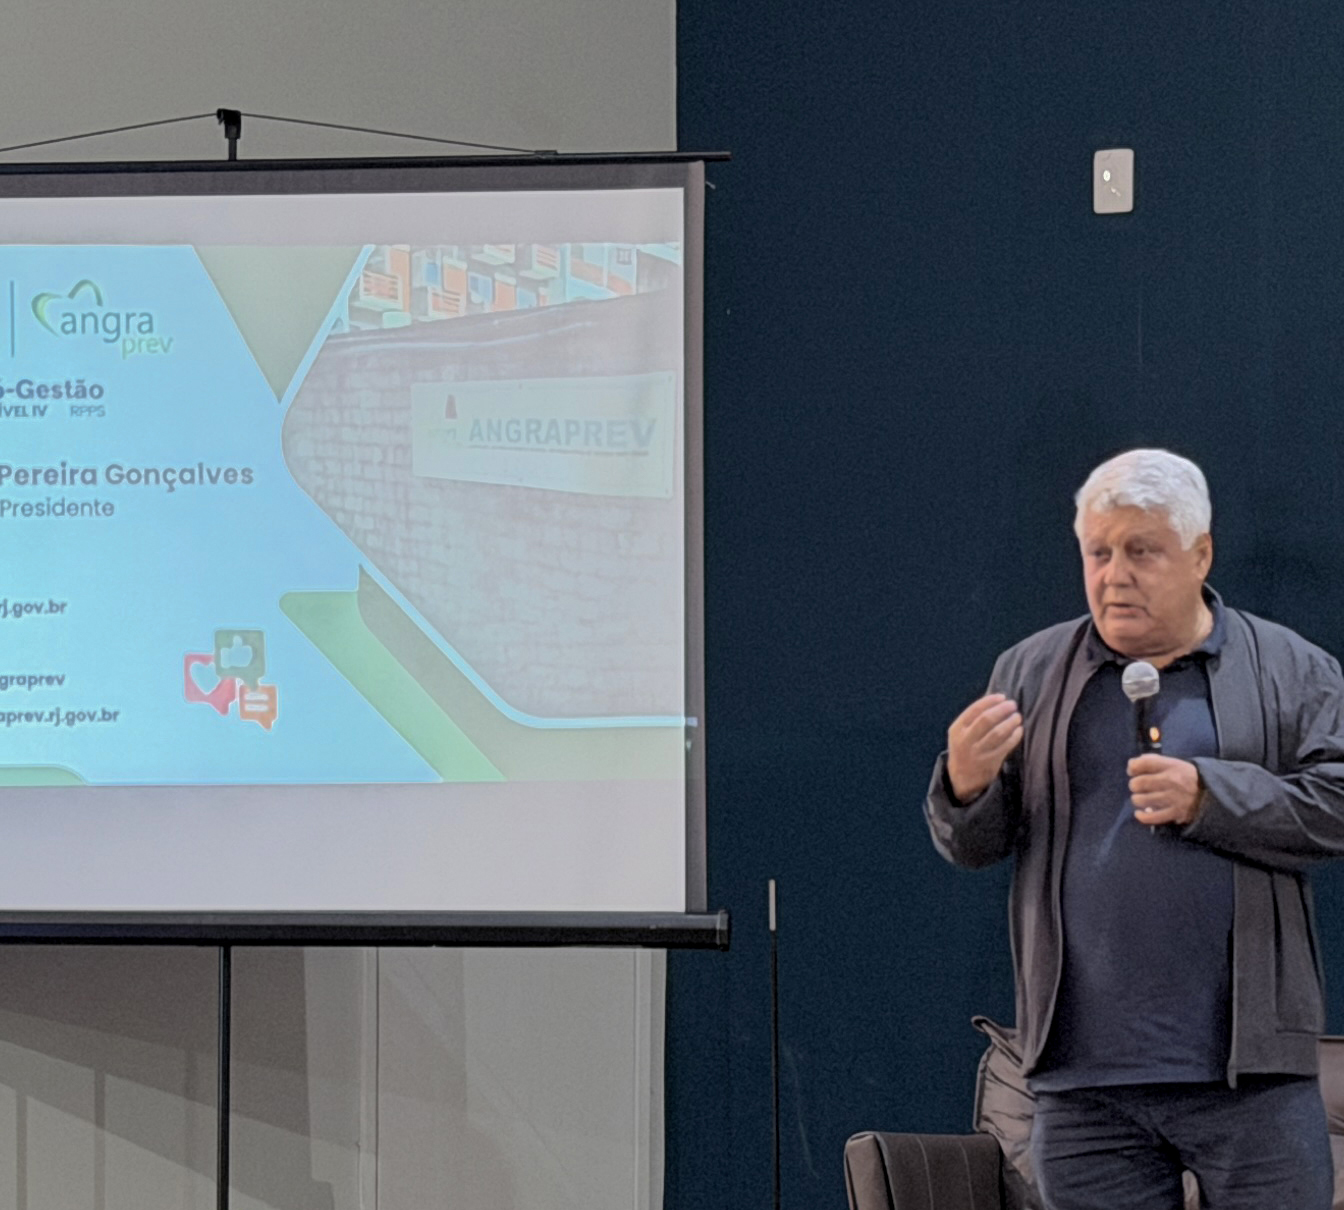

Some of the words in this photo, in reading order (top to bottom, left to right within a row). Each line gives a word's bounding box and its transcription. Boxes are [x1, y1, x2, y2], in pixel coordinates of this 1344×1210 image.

[60, 312, 154, 343] angra
[122, 337, 173, 360] prev
[32, 405, 49, 417] IV
[70, 405, 106, 418] RPPS
[469, 418, 656, 448] ANGRAPREV
[105, 461, 254, 493] Gonçalves
